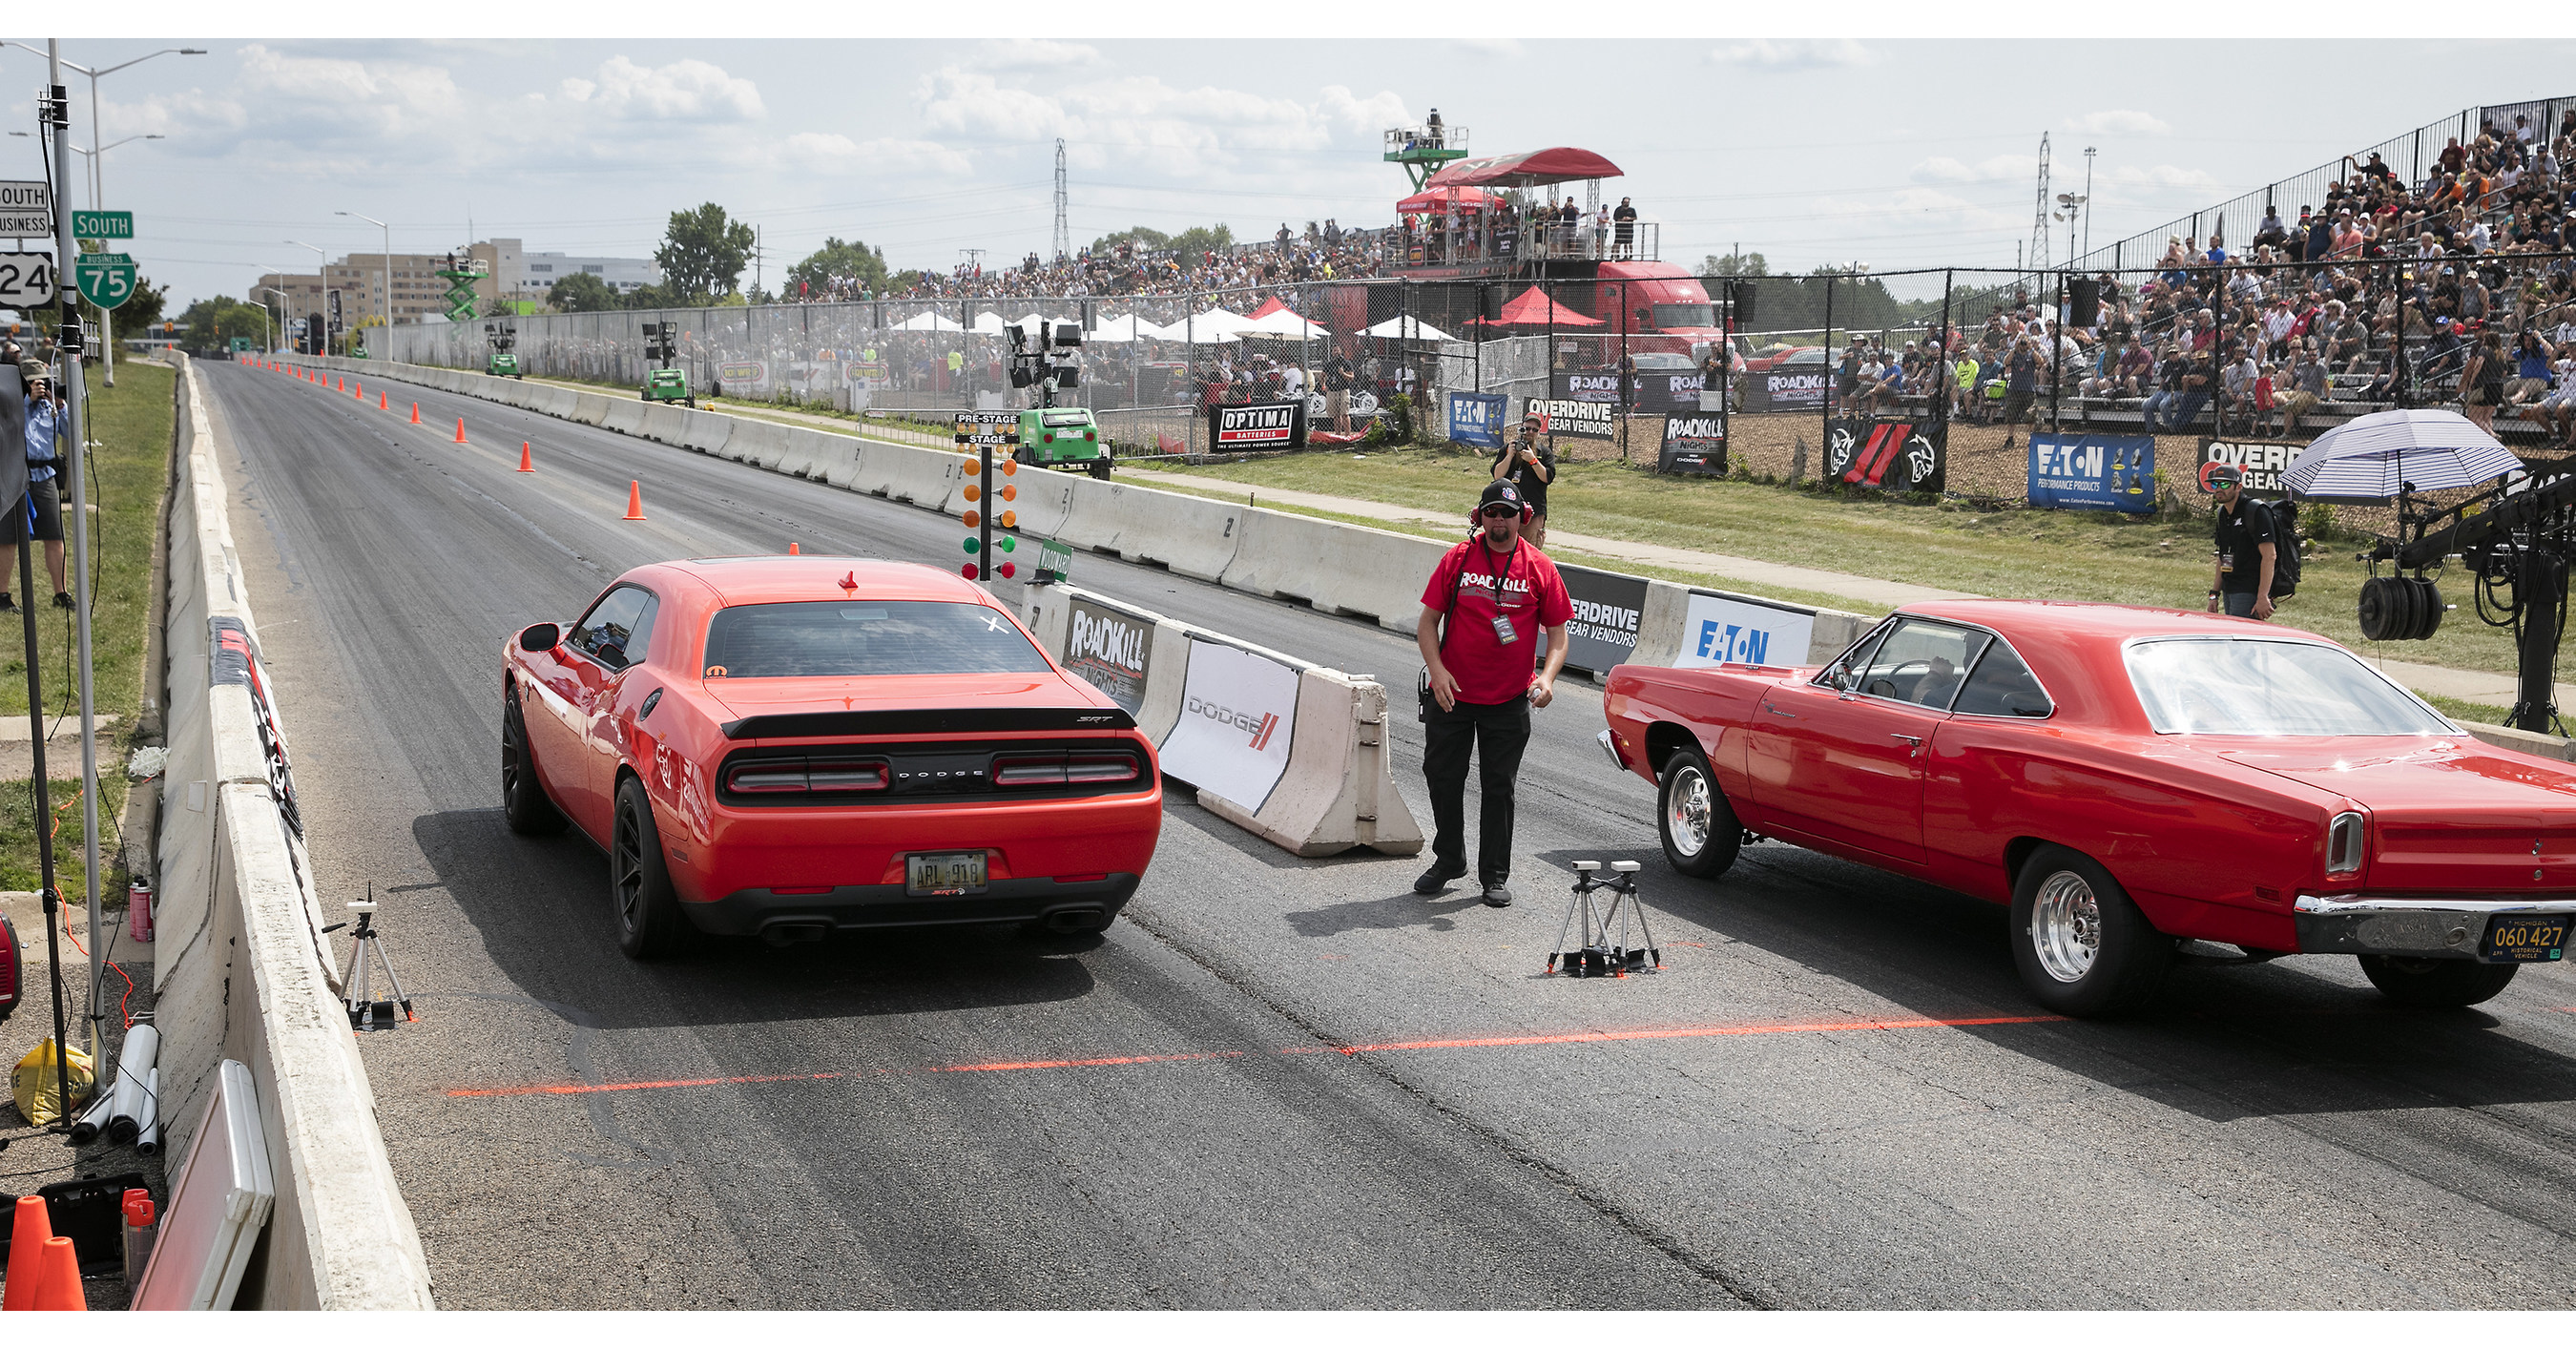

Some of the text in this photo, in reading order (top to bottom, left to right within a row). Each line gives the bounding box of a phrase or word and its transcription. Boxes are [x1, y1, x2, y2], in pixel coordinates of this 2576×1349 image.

[0, 188, 45, 205] OUTH
[0, 218, 46, 232] USINESS
[78, 215, 129, 235] SOUTH
[86, 255, 123, 264] BUSINESS
[0, 264, 49, 295] 24
[85, 270, 128, 298] 75
[958, 414, 1018, 425] PRE-STAGE
[1225, 409, 1288, 429] OPTIMA
[1454, 400, 1485, 424] EATON
[1528, 399, 1612, 422] OVERDRIVE
[1548, 419, 1614, 436] GEAR VENDORS
[1667, 418, 1723, 440] ROADKILL
[969, 435, 1007, 445] STAGE
[2037, 444, 2104, 478] EATON
[2037, 478, 2073, 490] PERFORMANCE
[2073, 480, 2101, 492] PRODUCTS
[1569, 598, 1639, 632] ERDRIVE
[1070, 610, 1145, 672] ROADKILL
[1565, 620, 1638, 648] GEAR VENDORS
[1696, 619, 1770, 665] EATON
[1189, 695, 1264, 737] DODGE
[899, 770, 984, 778] DODGE
[917, 863, 978, 886] ARL 918
[2495, 926, 2564, 947] 060 427
